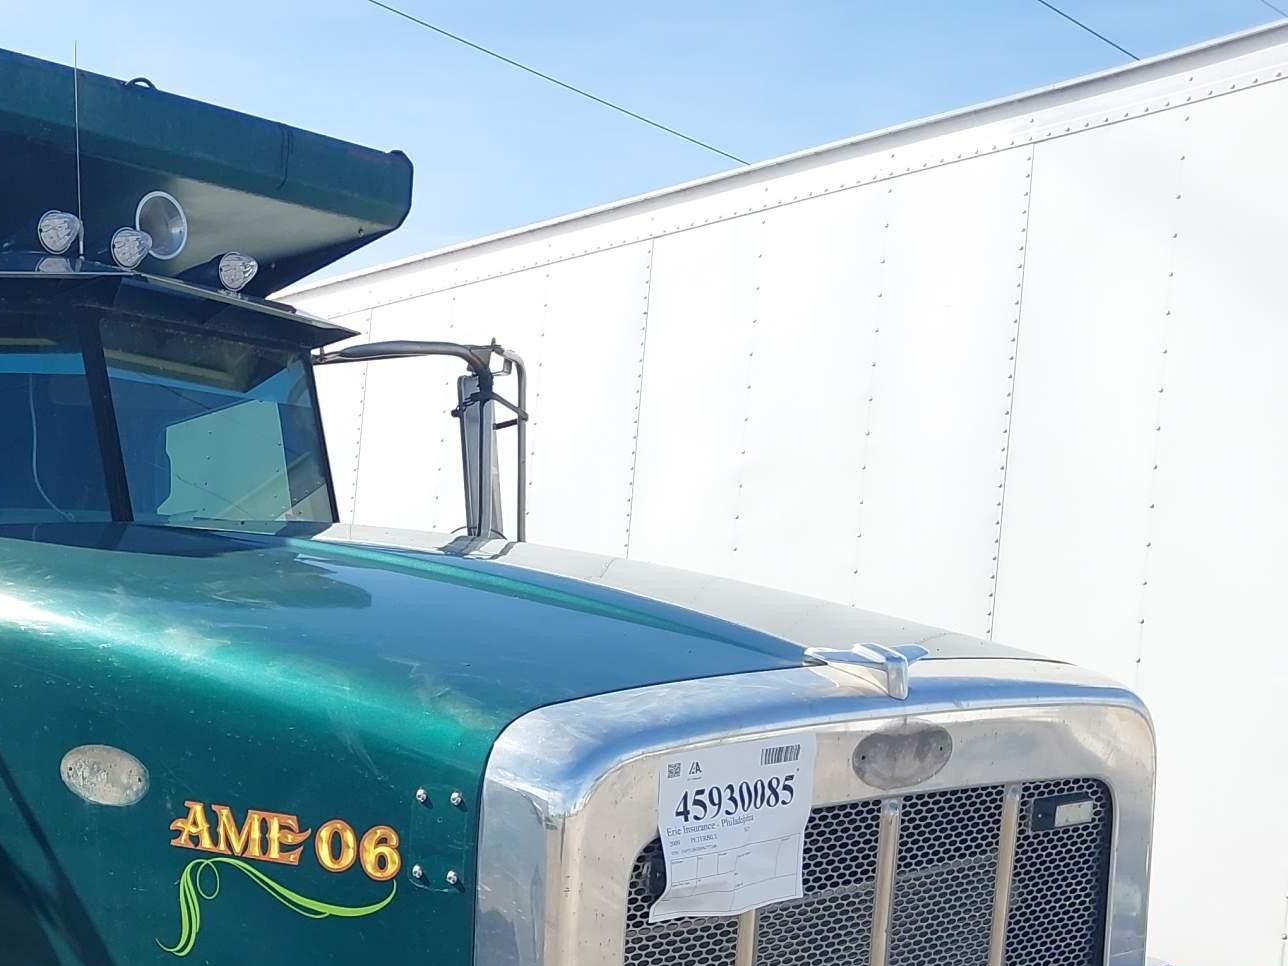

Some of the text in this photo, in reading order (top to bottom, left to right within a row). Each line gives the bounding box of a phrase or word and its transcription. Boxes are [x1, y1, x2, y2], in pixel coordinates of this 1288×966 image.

[674, 774, 795, 823] 45930085
[169, 800, 402, 881] AME 06
[666, 827, 682, 838] Erie
[682, 822, 716, 834] Insurance
